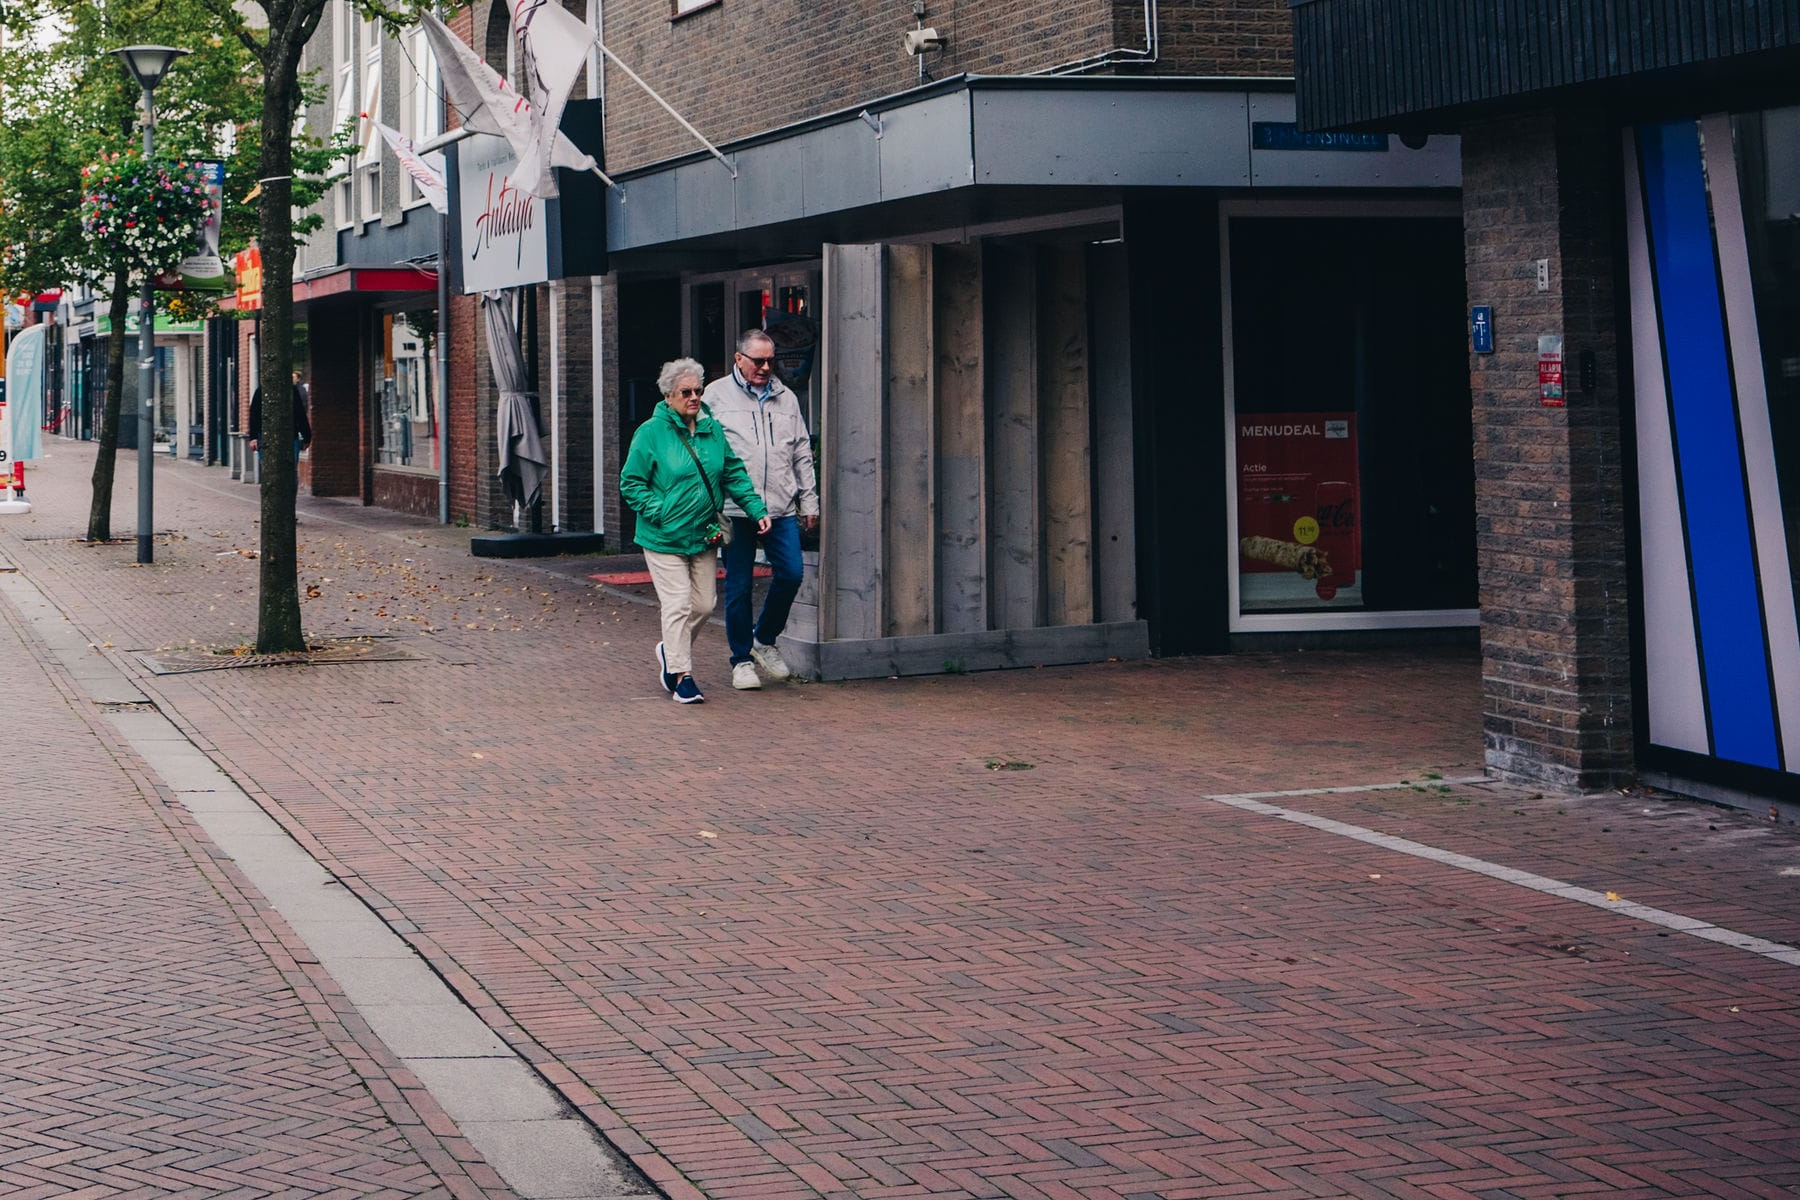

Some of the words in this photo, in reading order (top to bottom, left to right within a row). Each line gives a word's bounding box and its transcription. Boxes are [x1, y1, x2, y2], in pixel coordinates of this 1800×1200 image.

[472, 172, 534, 270] Antalya
[1242, 425, 1321, 437] MENUDEAL
[1243, 463, 1267, 473] Actie
